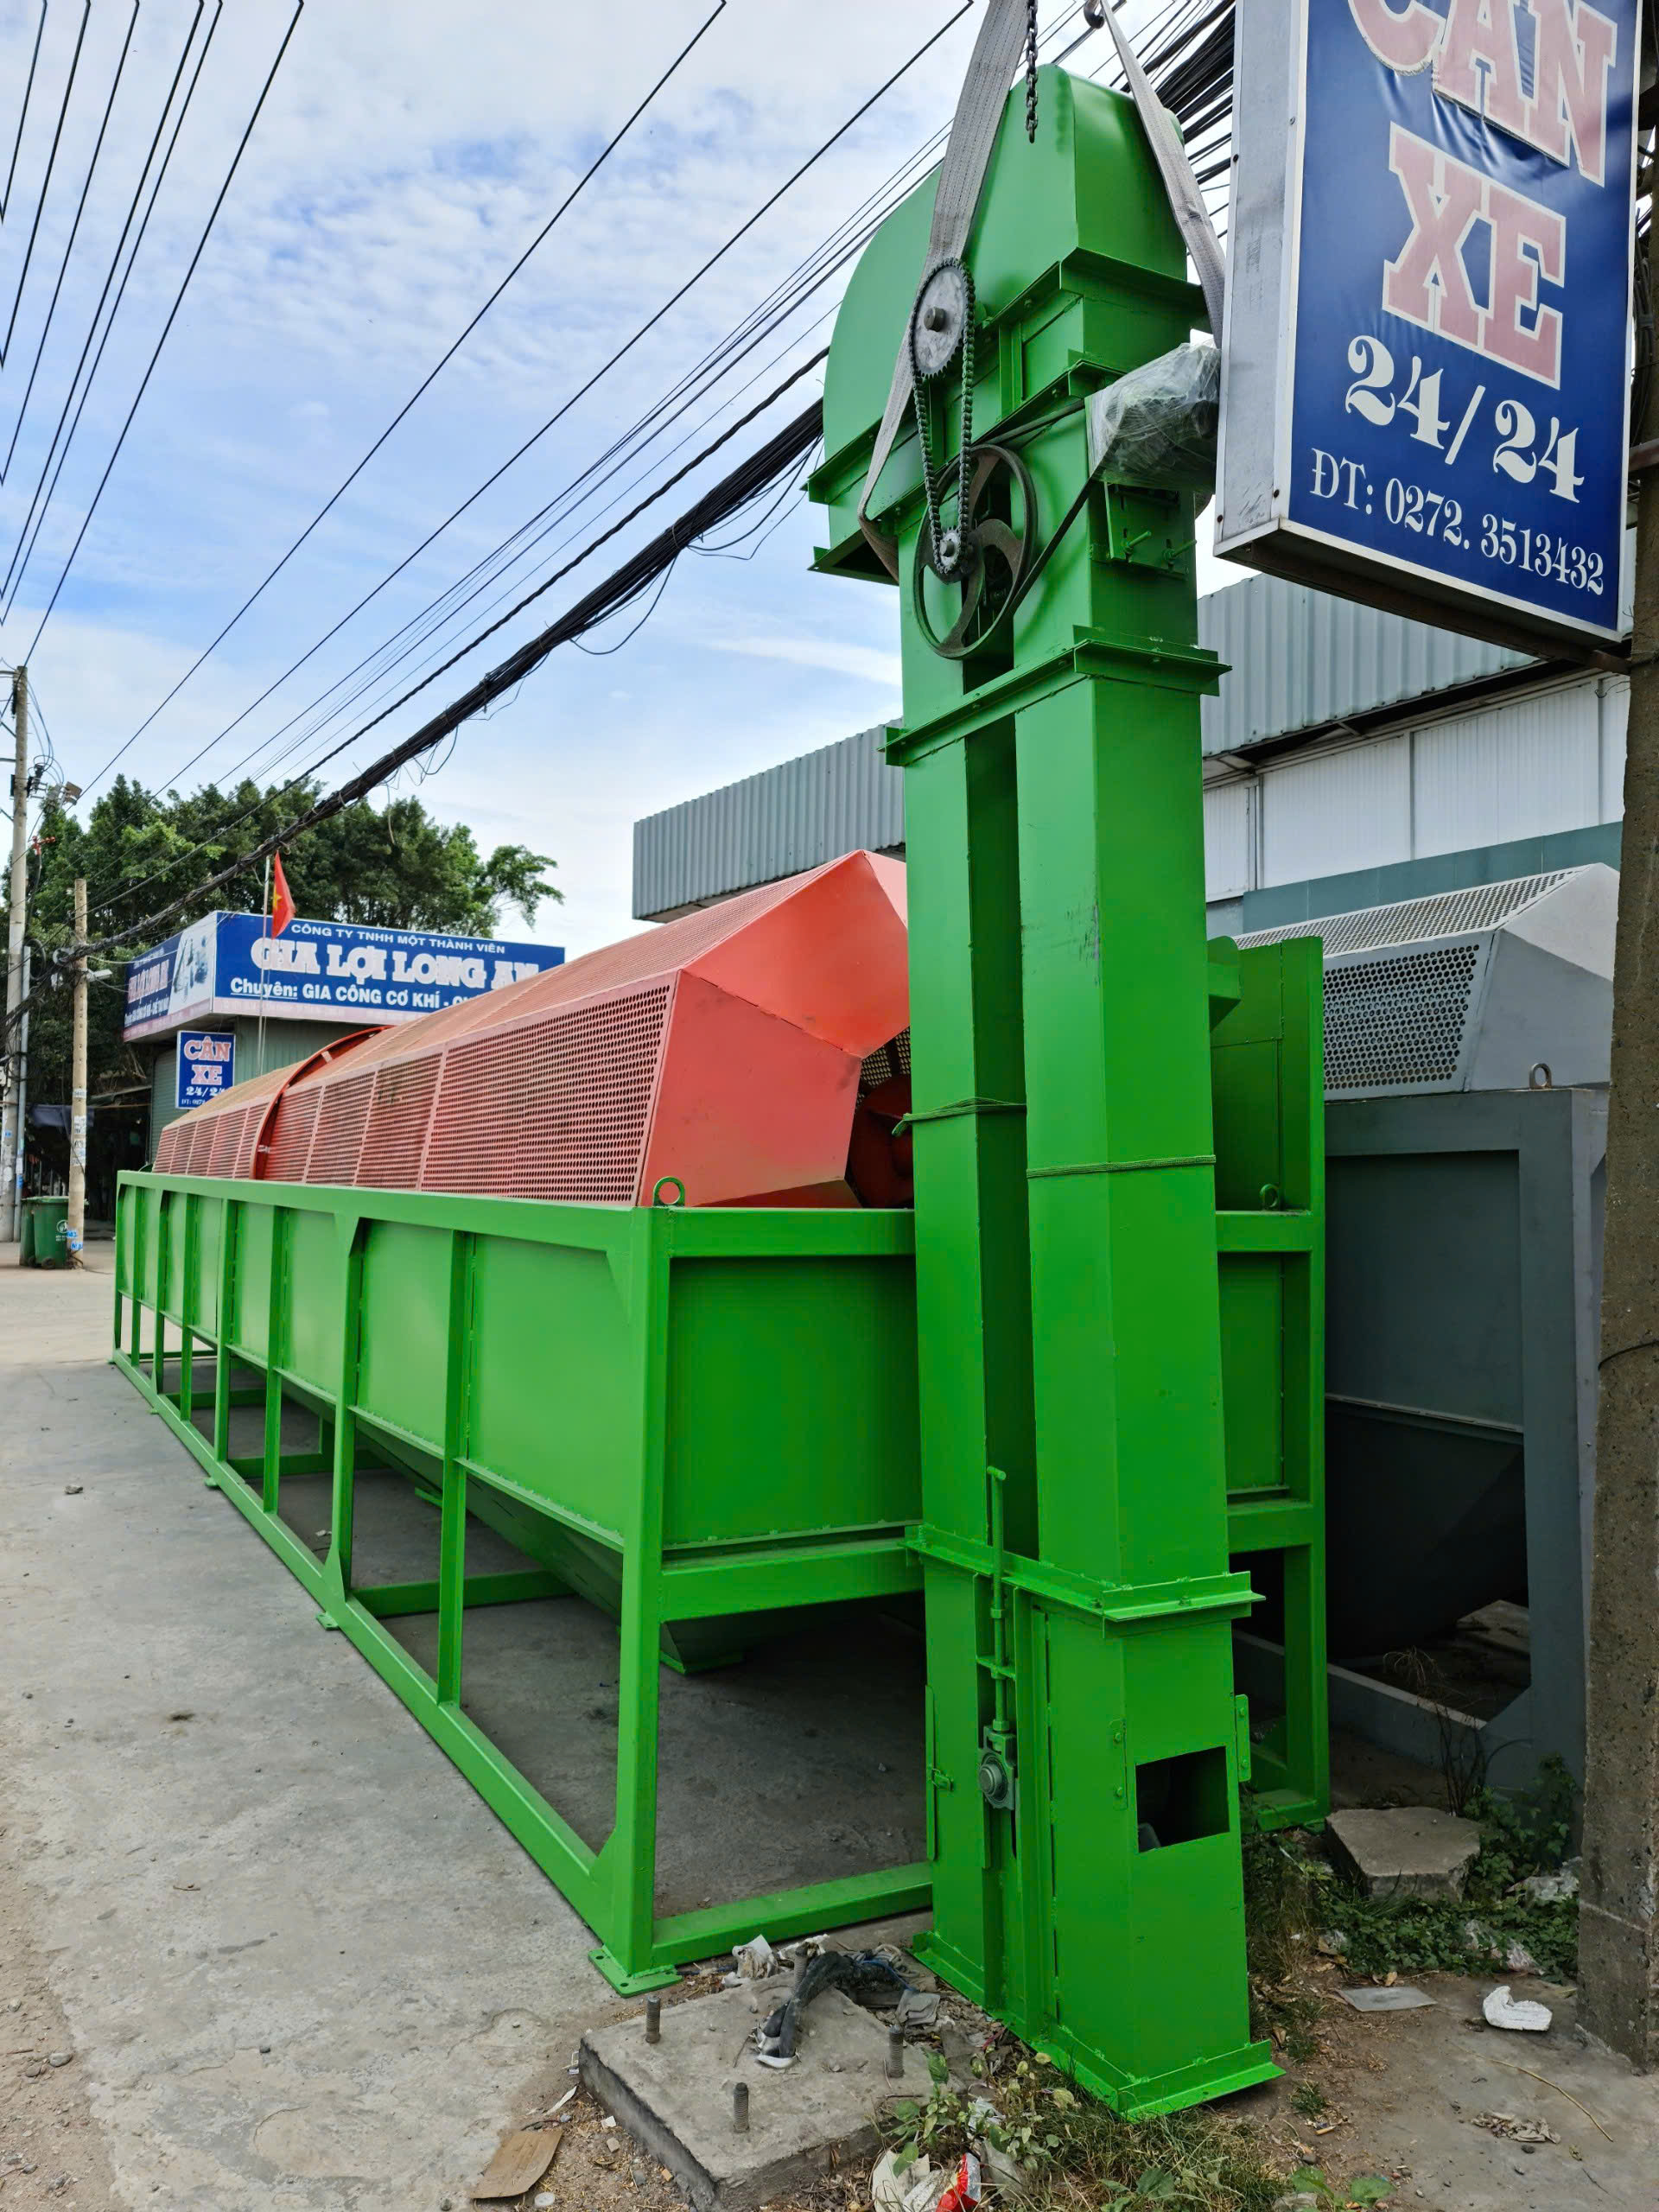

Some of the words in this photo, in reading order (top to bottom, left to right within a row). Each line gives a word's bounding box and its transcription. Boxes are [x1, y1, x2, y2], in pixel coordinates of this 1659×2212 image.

[1383, 121, 1567, 391] XE
[1344, 334, 1586, 504] 24/24
[1309, 448, 1374, 516] ĐT:
[1384, 478, 1471, 550] 0272.
[1480, 513, 1605, 596] 3513432
[291, 924, 333, 937] CÔNG
[335, 929, 353, 938] TY
[357, 931, 394, 944] TNHH
[397, 935, 426, 947] MỘT
[429, 938, 474, 950] THÀNH
[476, 943, 505, 954] VIÊN
[251, 938, 321, 975] GIA
[326, 944, 387, 985] LỢI
[392, 952, 487, 988] LONG
[230, 977, 298, 999] Chuyên:
[302, 983, 332, 1000] GIA
[335, 984, 382, 1004] CÔNG
[385, 989, 409, 1007] CƠ
[412, 991, 441, 1009] KHÍ
[184, 1036, 232, 1062] CÂN
[191, 1065, 222, 1085] XE
